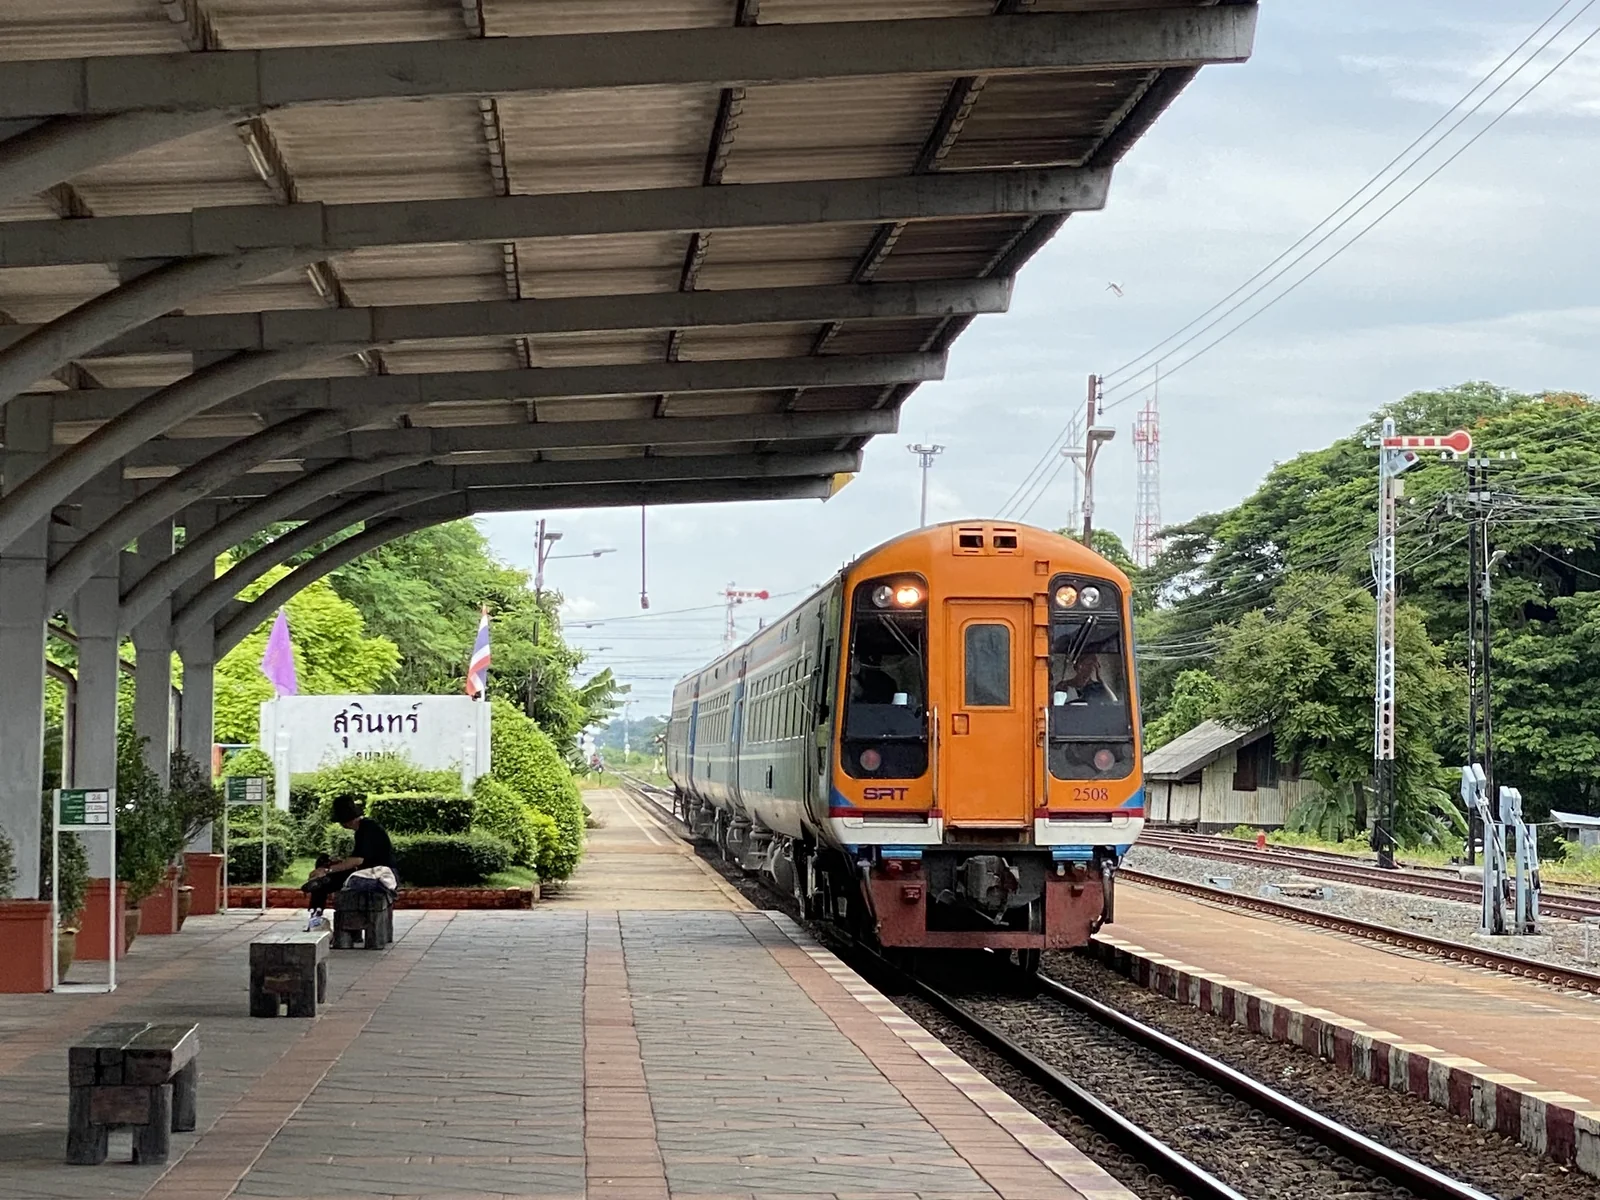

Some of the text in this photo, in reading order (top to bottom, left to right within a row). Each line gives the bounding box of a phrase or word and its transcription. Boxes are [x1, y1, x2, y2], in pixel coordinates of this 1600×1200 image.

[334, 702, 422, 748] สุรินทร์
[863, 787, 909, 801] SRT
[1073, 787, 1109, 802] 2508
